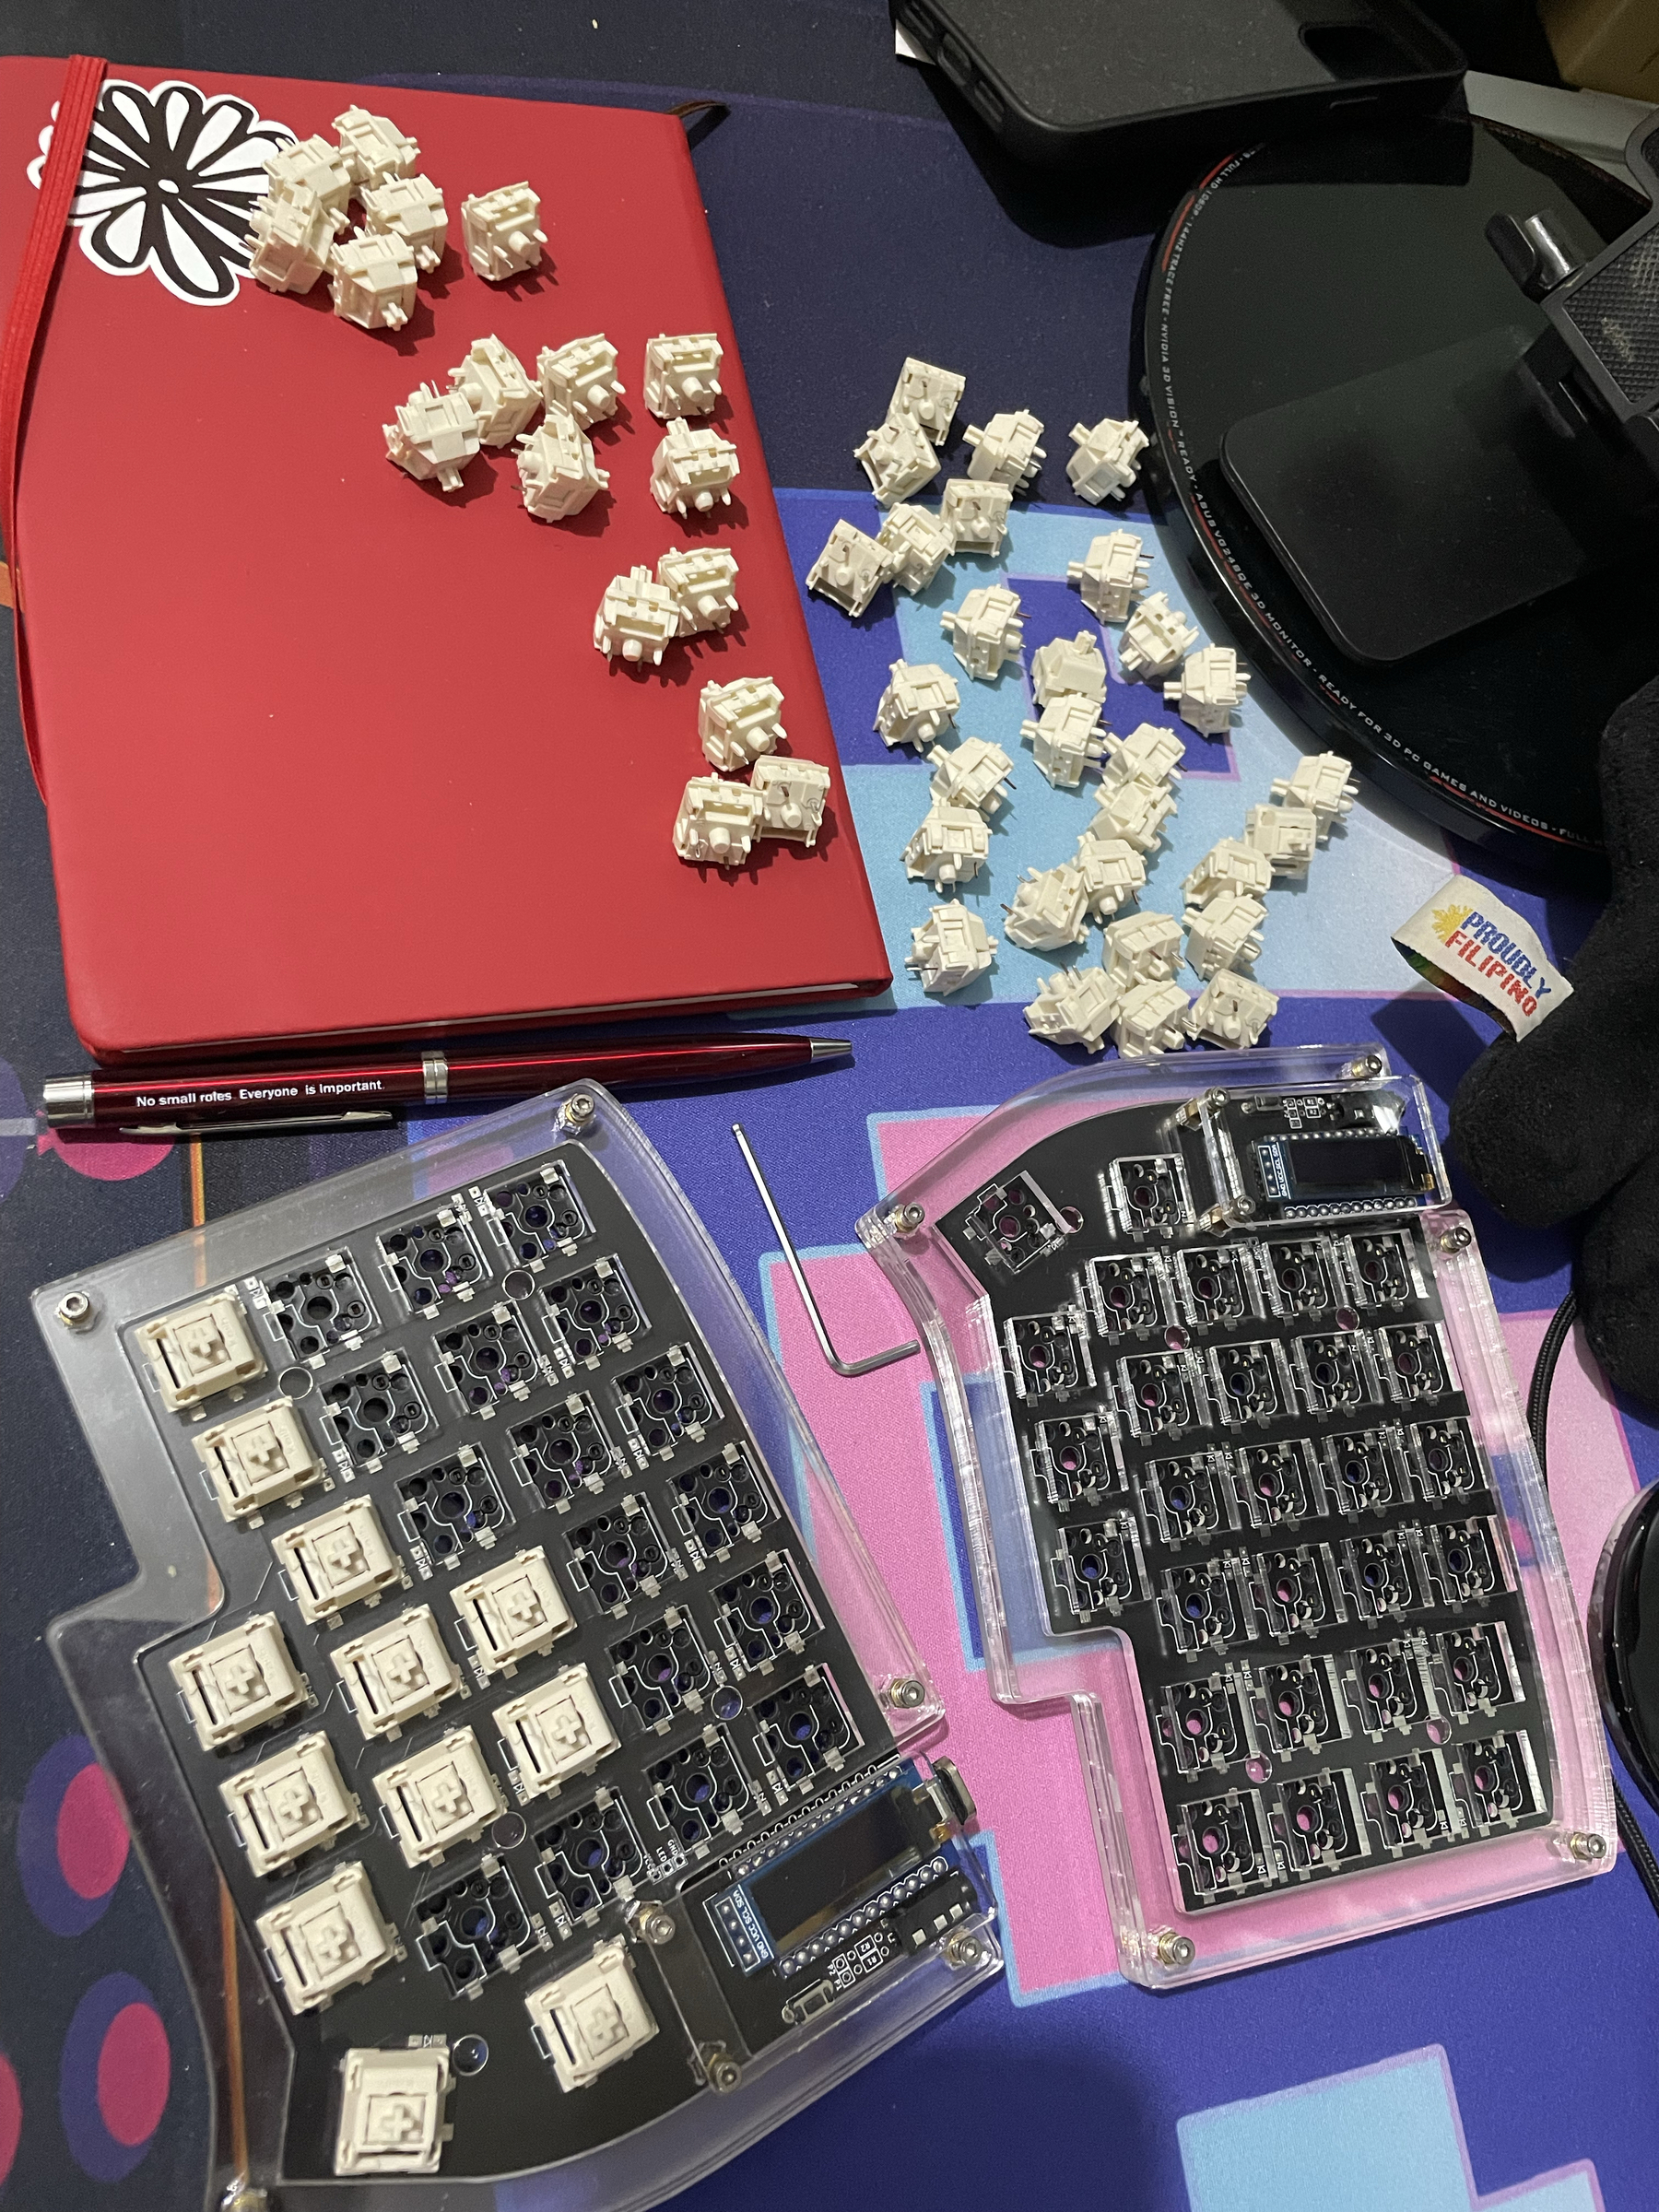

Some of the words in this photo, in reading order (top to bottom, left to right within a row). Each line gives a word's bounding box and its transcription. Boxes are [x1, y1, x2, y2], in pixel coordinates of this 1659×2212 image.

[1160, 323, 1170, 362] NVIDIA
[1161, 366, 1171, 382] 3D
[1177, 440, 1198, 482] READY
[1250, 592, 1266, 609] 3D
[1265, 612, 1312, 667] MONITOR
[1318, 674, 1358, 710] READY
[1357, 711, 1382, 735] FOR
[1383, 732, 1402, 748] 3D
[1404, 747, 1421, 762] PC
[1423, 760, 1467, 792] GAMES
[1469, 790, 1498, 808] AND
[1500, 804, 1548, 830] VIDEOS
[1460, 911, 1552, 1000] PROUDLY
[1444, 930, 1537, 1017] FILIPINO
[136, 1096, 156, 1107] No
[159, 1093, 196, 1106] small
[239, 1087, 299, 1100] Everyone
[305, 1084, 317, 1095] is
[655, 1846, 667, 1862] LED
[667, 1839, 678, 1855] GND
[741, 1906, 753, 1924] SCL
[757, 1941, 769, 1959] GND
[860, 1941, 871, 1952] R2
[827, 1963, 836, 1976] P2
[866, 1955, 877, 1966] R1
